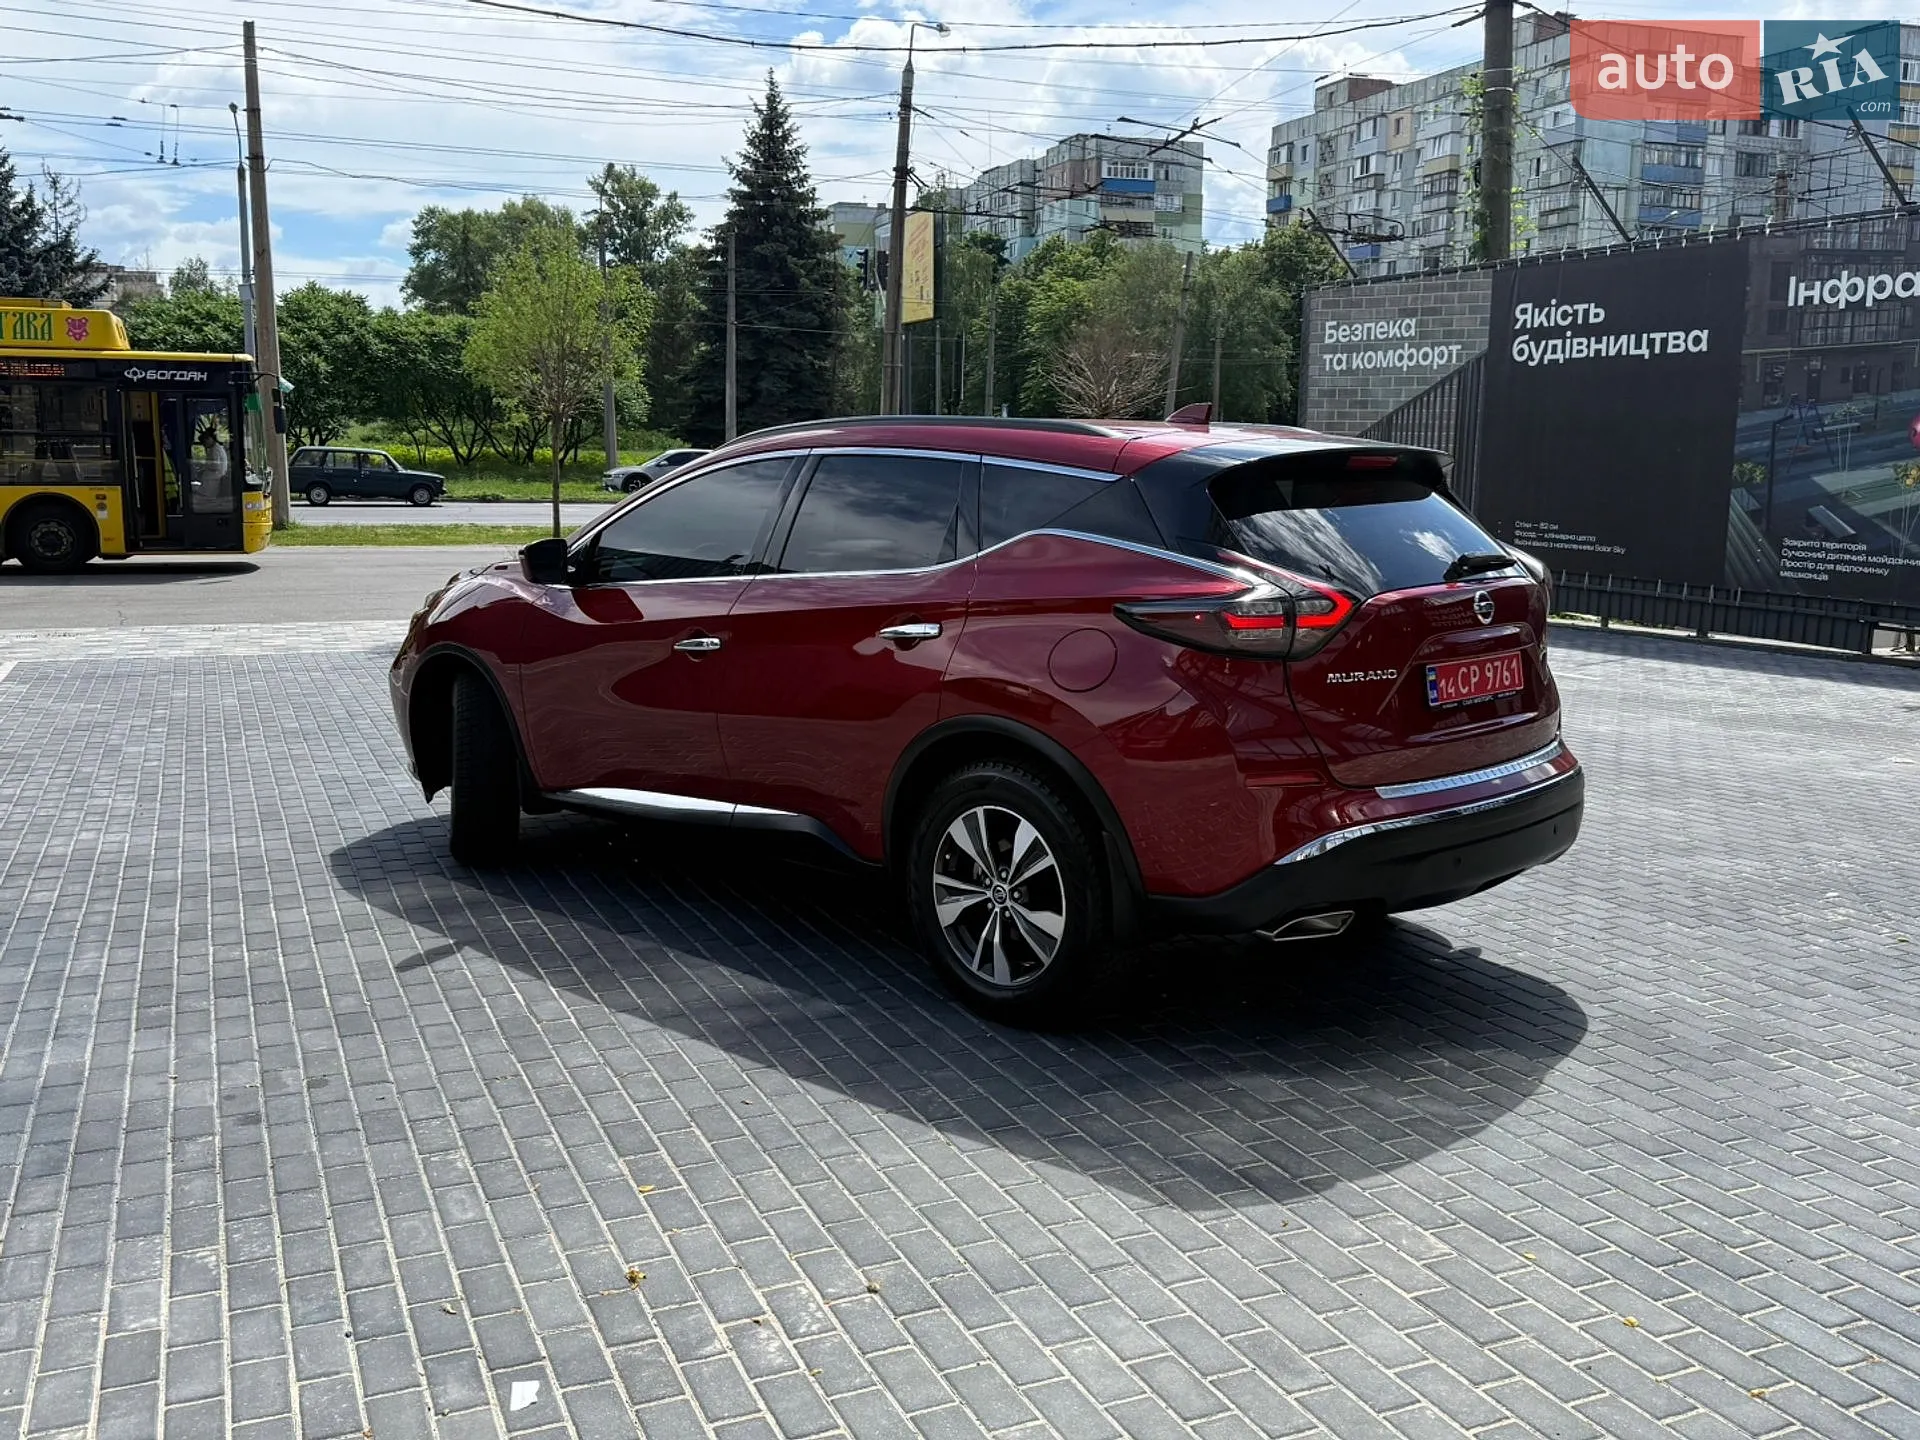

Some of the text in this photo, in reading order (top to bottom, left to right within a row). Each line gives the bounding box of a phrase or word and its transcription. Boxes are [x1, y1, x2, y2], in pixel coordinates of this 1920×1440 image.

[1787, 270, 1920, 309] Інфра
[1514, 298, 1605, 329] Якість
[1324, 318, 1416, 343] Безпека
[1323, 343, 1461, 371] та комфорт
[1511, 329, 1709, 366] будівництва
[146, 369, 208, 381] БОГДАН
[1780, 559, 1815, 570] Простір
[1327, 669, 1398, 683] MURANO
[1485, 657, 1519, 690] 9761
